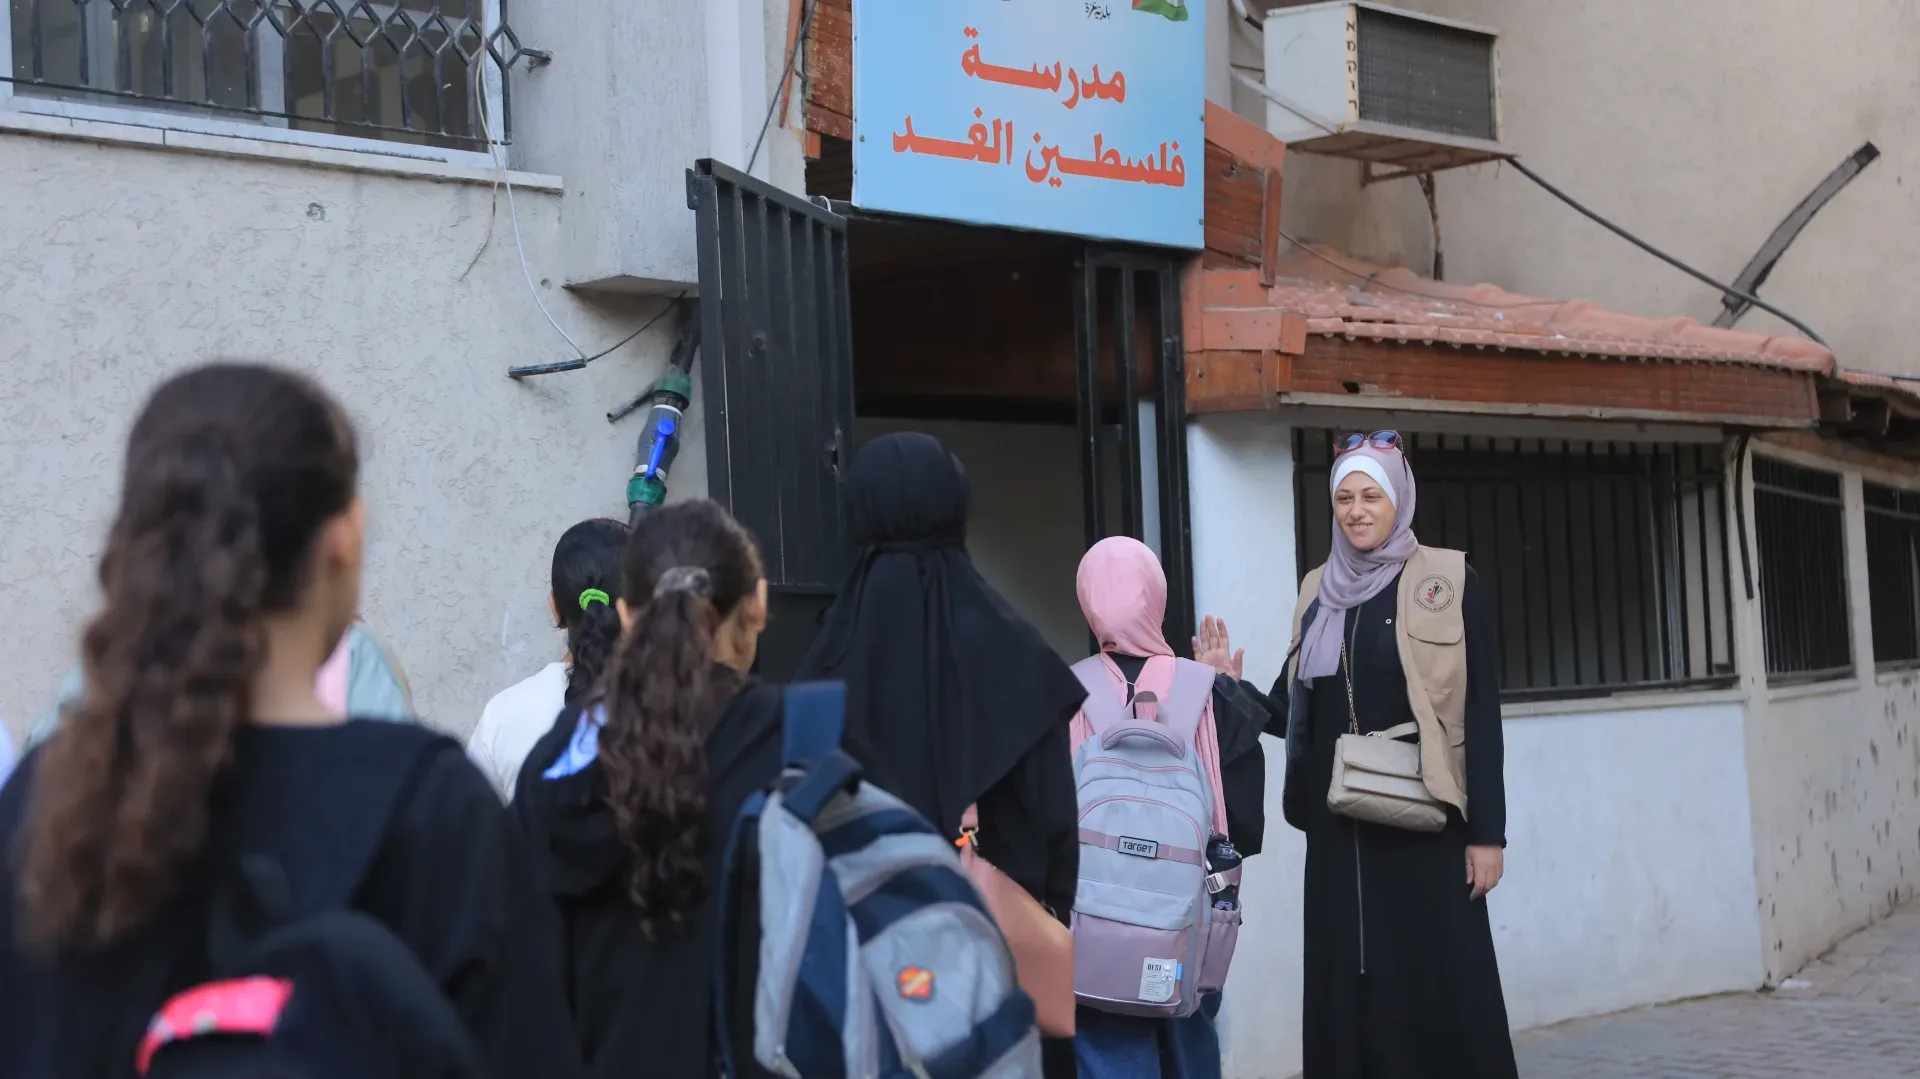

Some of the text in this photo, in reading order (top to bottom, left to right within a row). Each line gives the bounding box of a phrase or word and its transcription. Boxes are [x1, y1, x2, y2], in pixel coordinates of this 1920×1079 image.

[961, 26, 1126, 109] مدرسة
[892, 106, 1186, 188] فلسطين الغد
